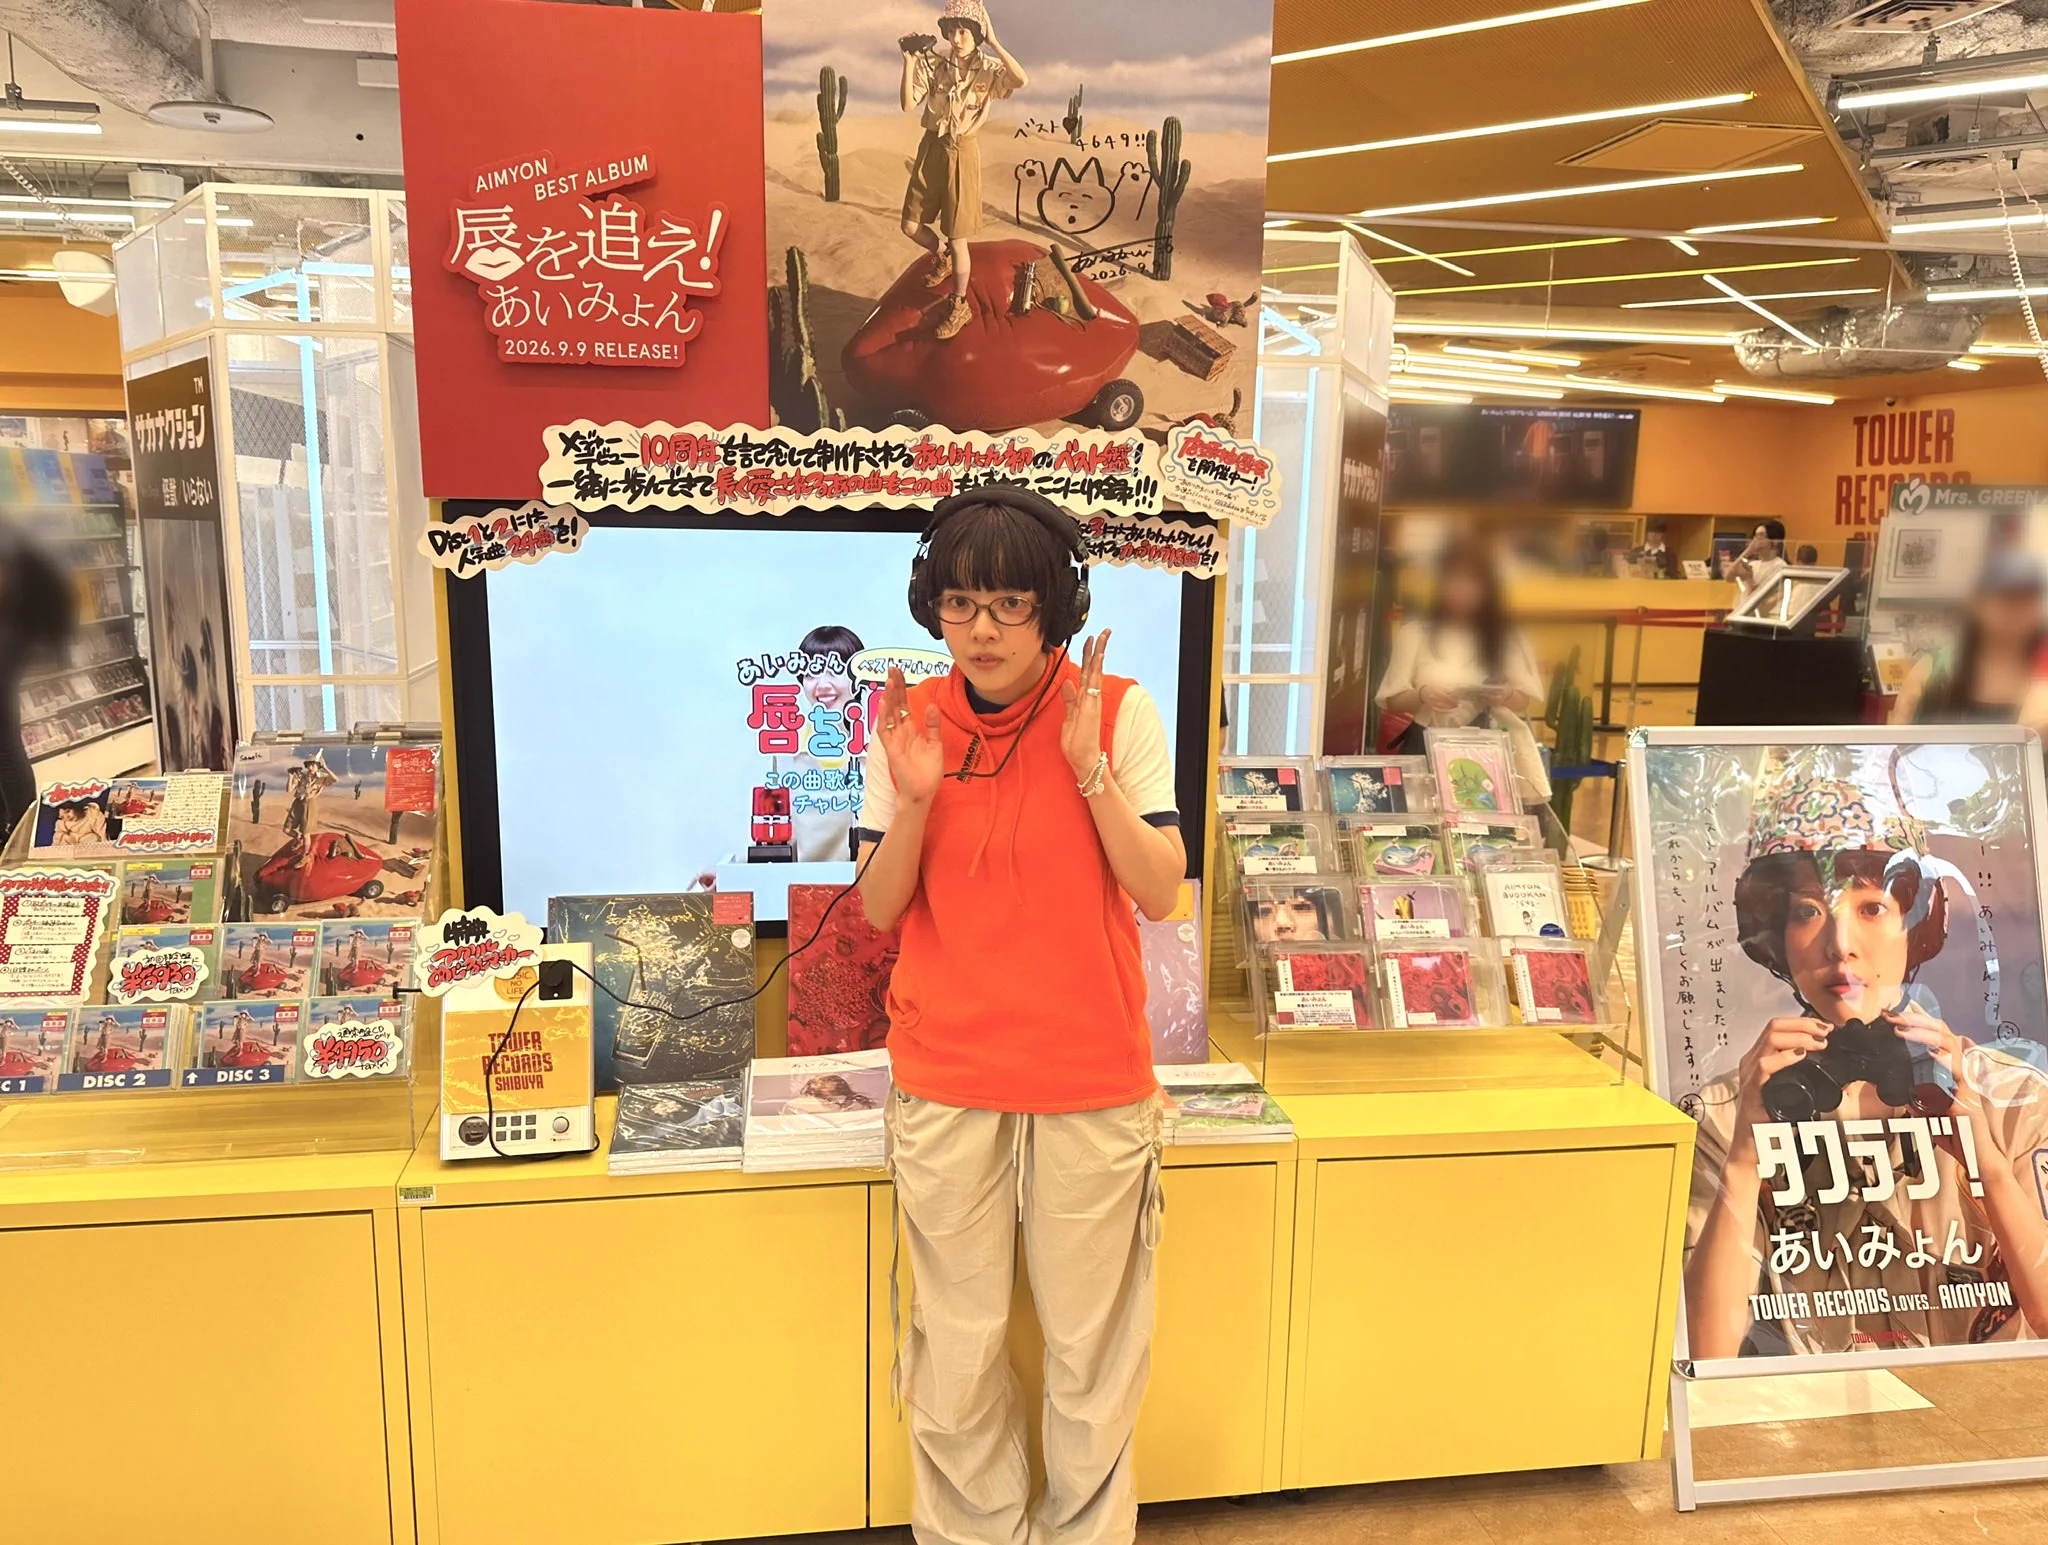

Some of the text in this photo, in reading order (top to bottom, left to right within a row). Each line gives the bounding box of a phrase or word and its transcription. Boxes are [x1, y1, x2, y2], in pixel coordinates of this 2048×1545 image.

[1014, 118, 1058, 139] ベスト
[476, 157, 548, 193] AIMYON
[534, 154, 649, 201] BEST ALBUM
[450, 202, 729, 289] 唇を追え!
[486, 281, 697, 334] あいみょん
[505, 340, 679, 360] 2026.9.9 RELEASE!
[135, 404, 206, 454] サカナクション
[1853, 408, 1955, 467] TOWER
[1934, 489, 1972, 505] Mrs.
[737, 650, 846, 686] あいみょん
[120, 961, 197, 998] ¥6930
[1978, 905, 2000, 1021] あいみんです
[313, 1035, 389, 1074] ¥4950
[488, 1031, 543, 1053] TOWER
[83, 1073, 146, 1089] DISC 2
[216, 1069, 271, 1083] DISC 3
[481, 1052, 554, 1076] RECORDS
[494, 1074, 545, 1092] SHIBUYA
[1769, 1220, 1983, 1275] あいみょん
[1749, 1292, 1812, 1321] TOWER
[1816, 1287, 1892, 1319] RECORDS
[1938, 1281, 2014, 1310] AIMYON
